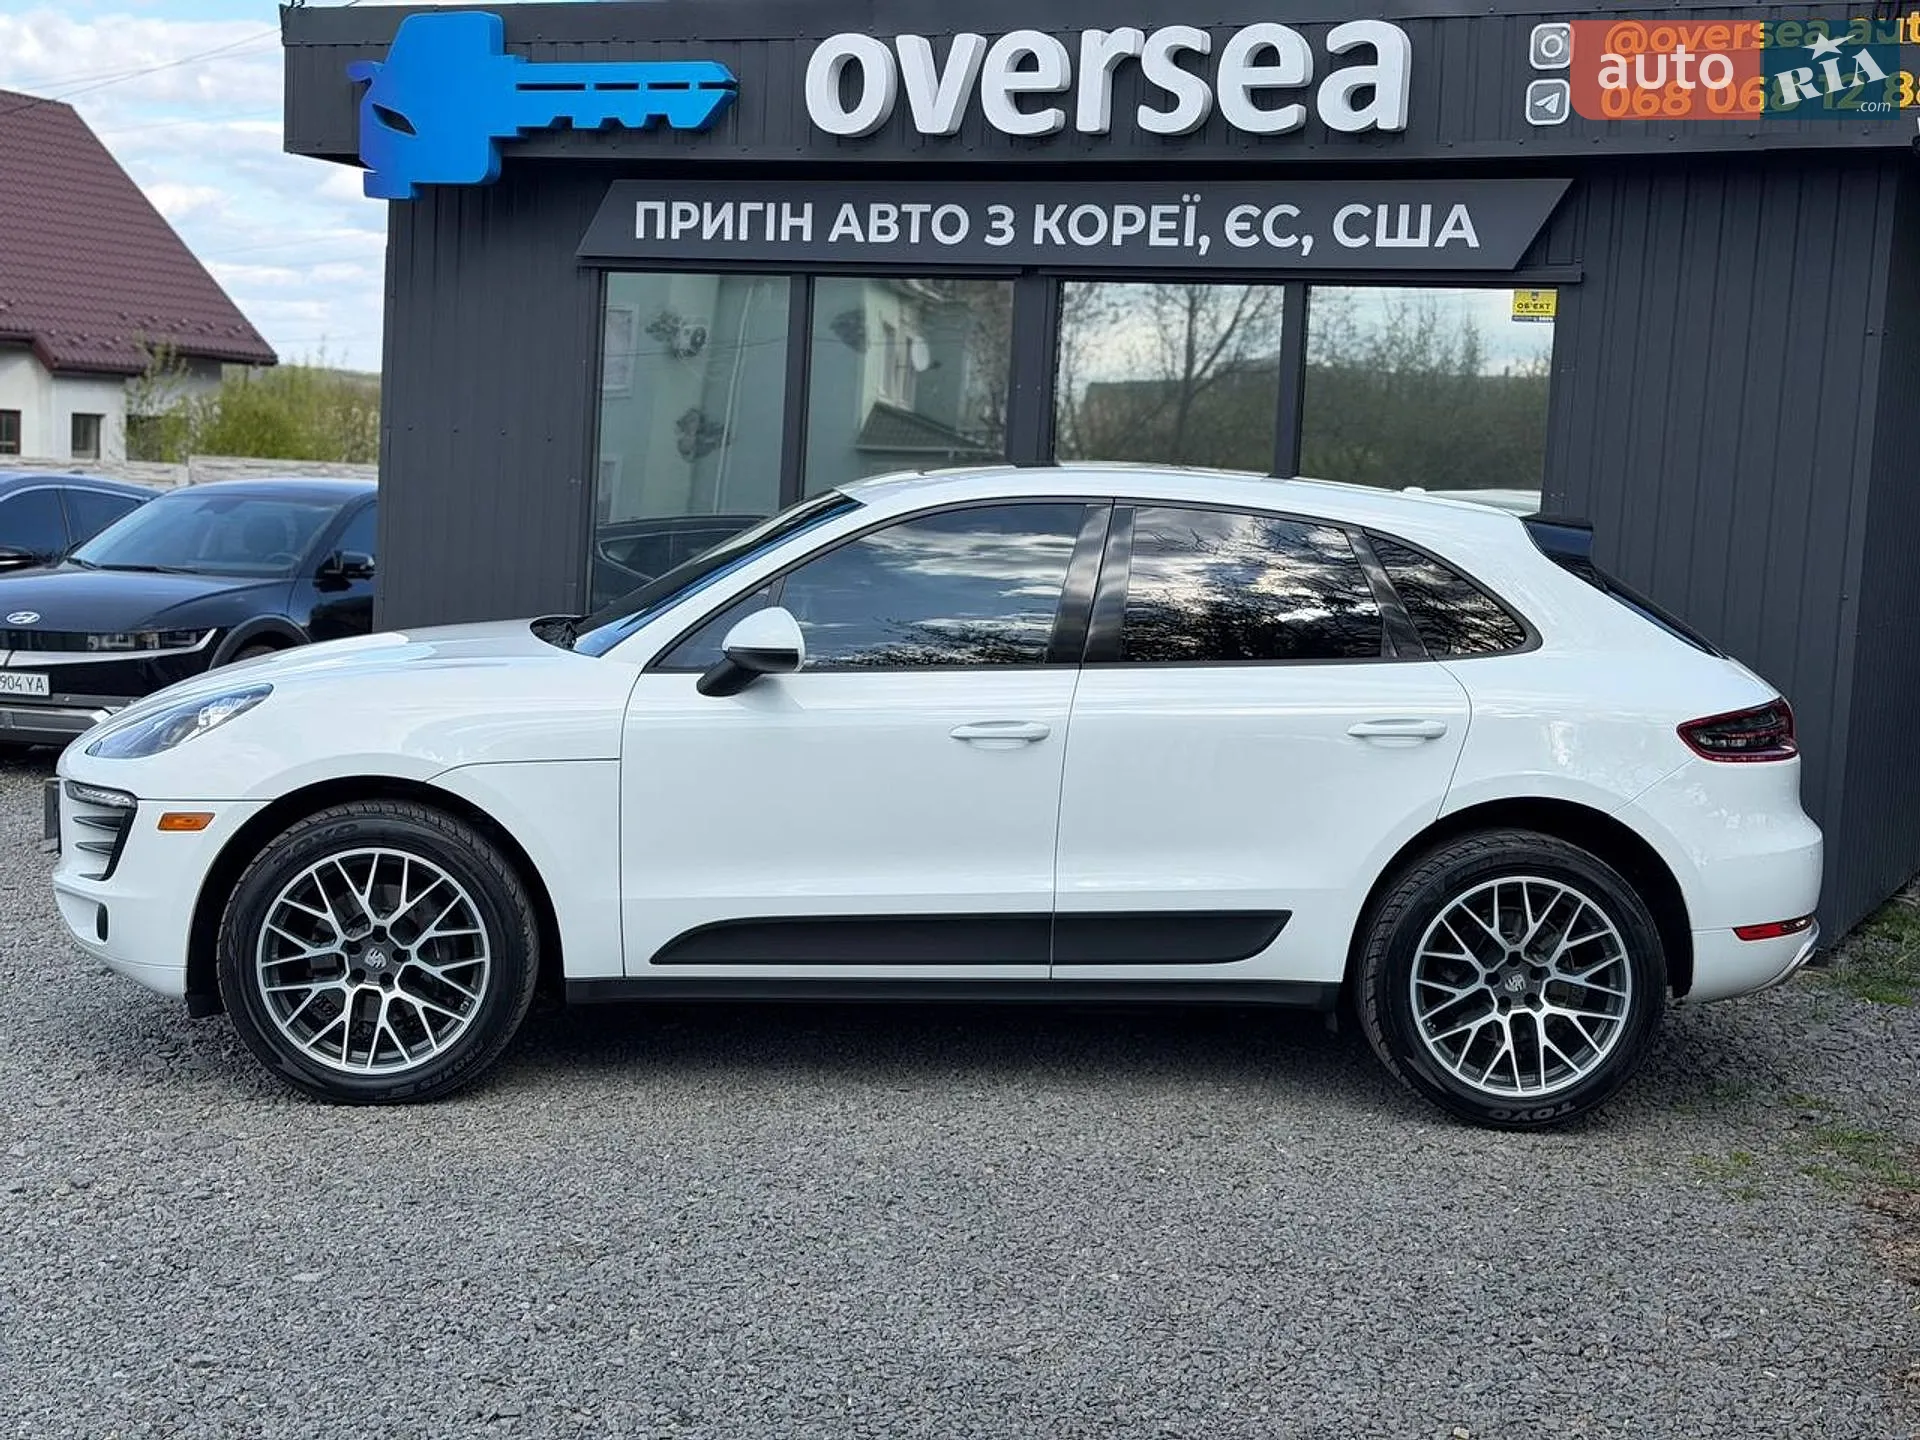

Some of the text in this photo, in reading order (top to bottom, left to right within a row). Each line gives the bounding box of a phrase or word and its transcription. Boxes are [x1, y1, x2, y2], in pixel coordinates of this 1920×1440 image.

[805, 19, 1411, 137] oversea
[1882, 70, 1920, 110] 8
[634, 200, 814, 242] ПРИГІН
[828, 203, 971, 245] АВТО
[1033, 193, 1211, 257] КОРЕЇ,
[1224, 203, 1314, 256] ЄС,
[1332, 203, 1480, 248] США
[1488, 1102, 1577, 1122] TOYO
